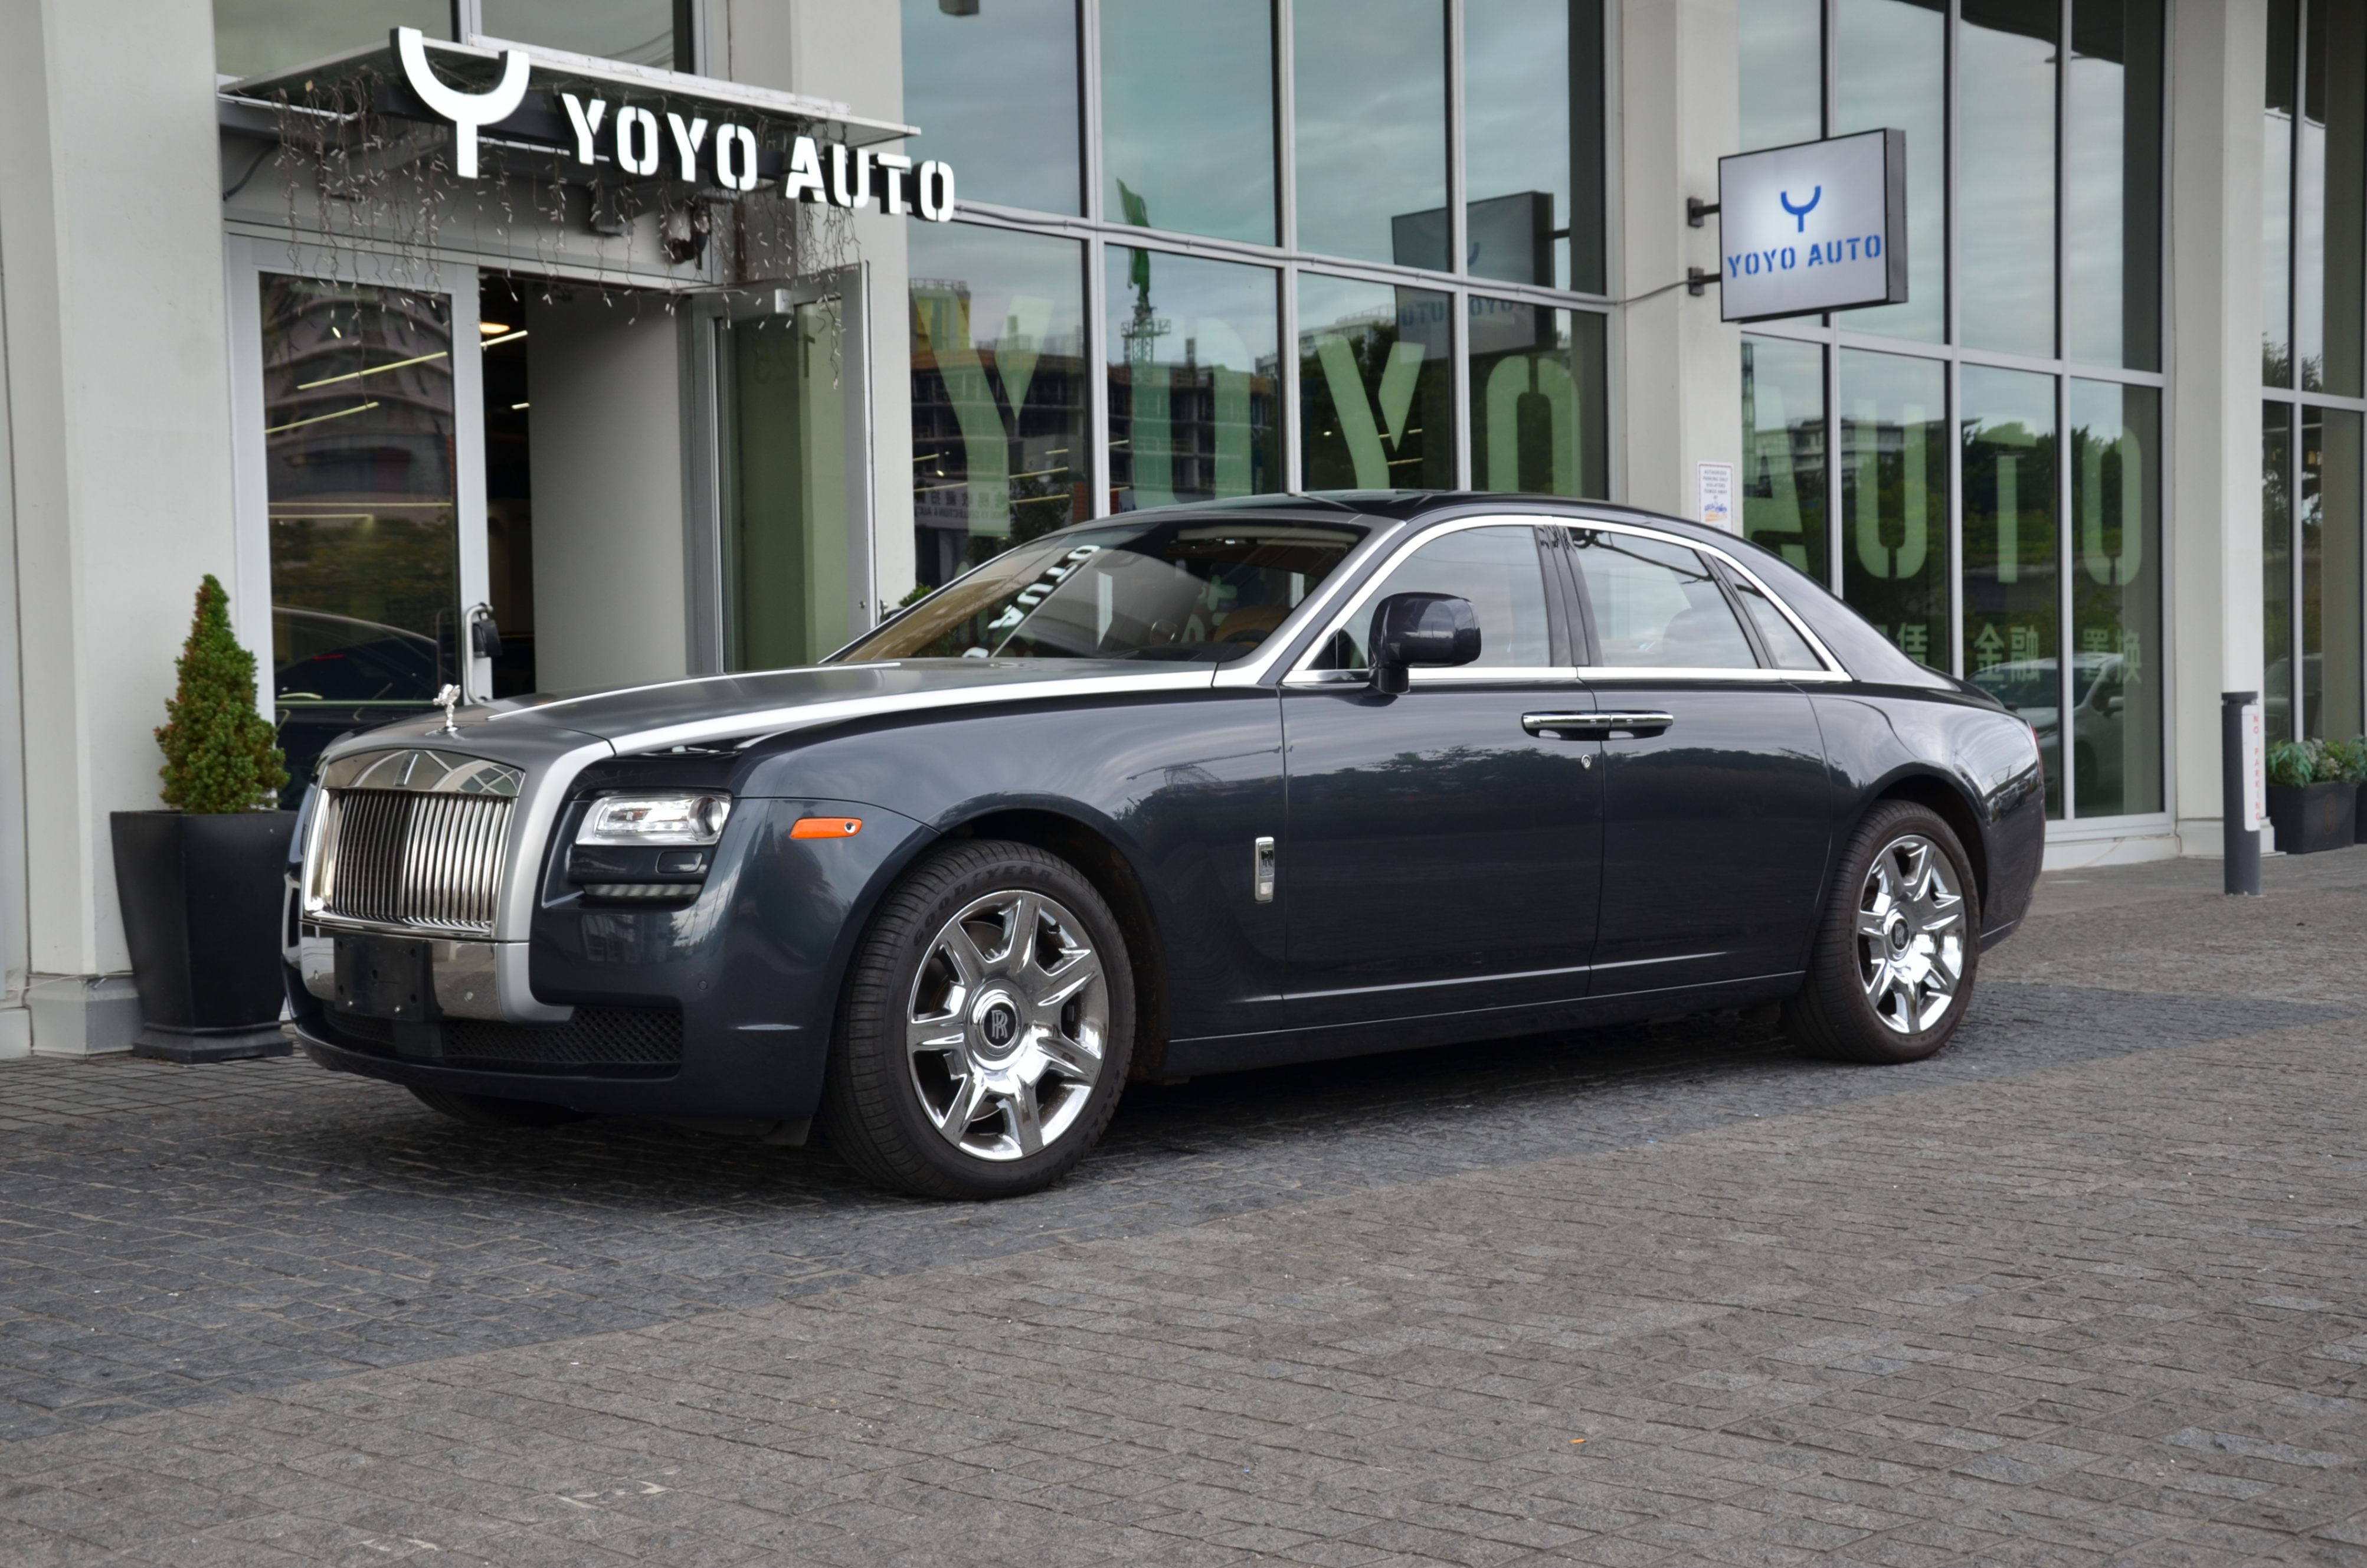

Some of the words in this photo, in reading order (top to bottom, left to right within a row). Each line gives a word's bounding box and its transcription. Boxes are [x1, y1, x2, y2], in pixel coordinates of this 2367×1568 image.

[561, 93, 757, 191] YOYO
[785, 136, 954, 222] AUTO
[1727, 247, 1796, 279] YOYO
[1807, 234, 1882, 267] AUTO
[1973, 623, 2040, 682] 金融
[2253, 715, 2260, 734] NO
